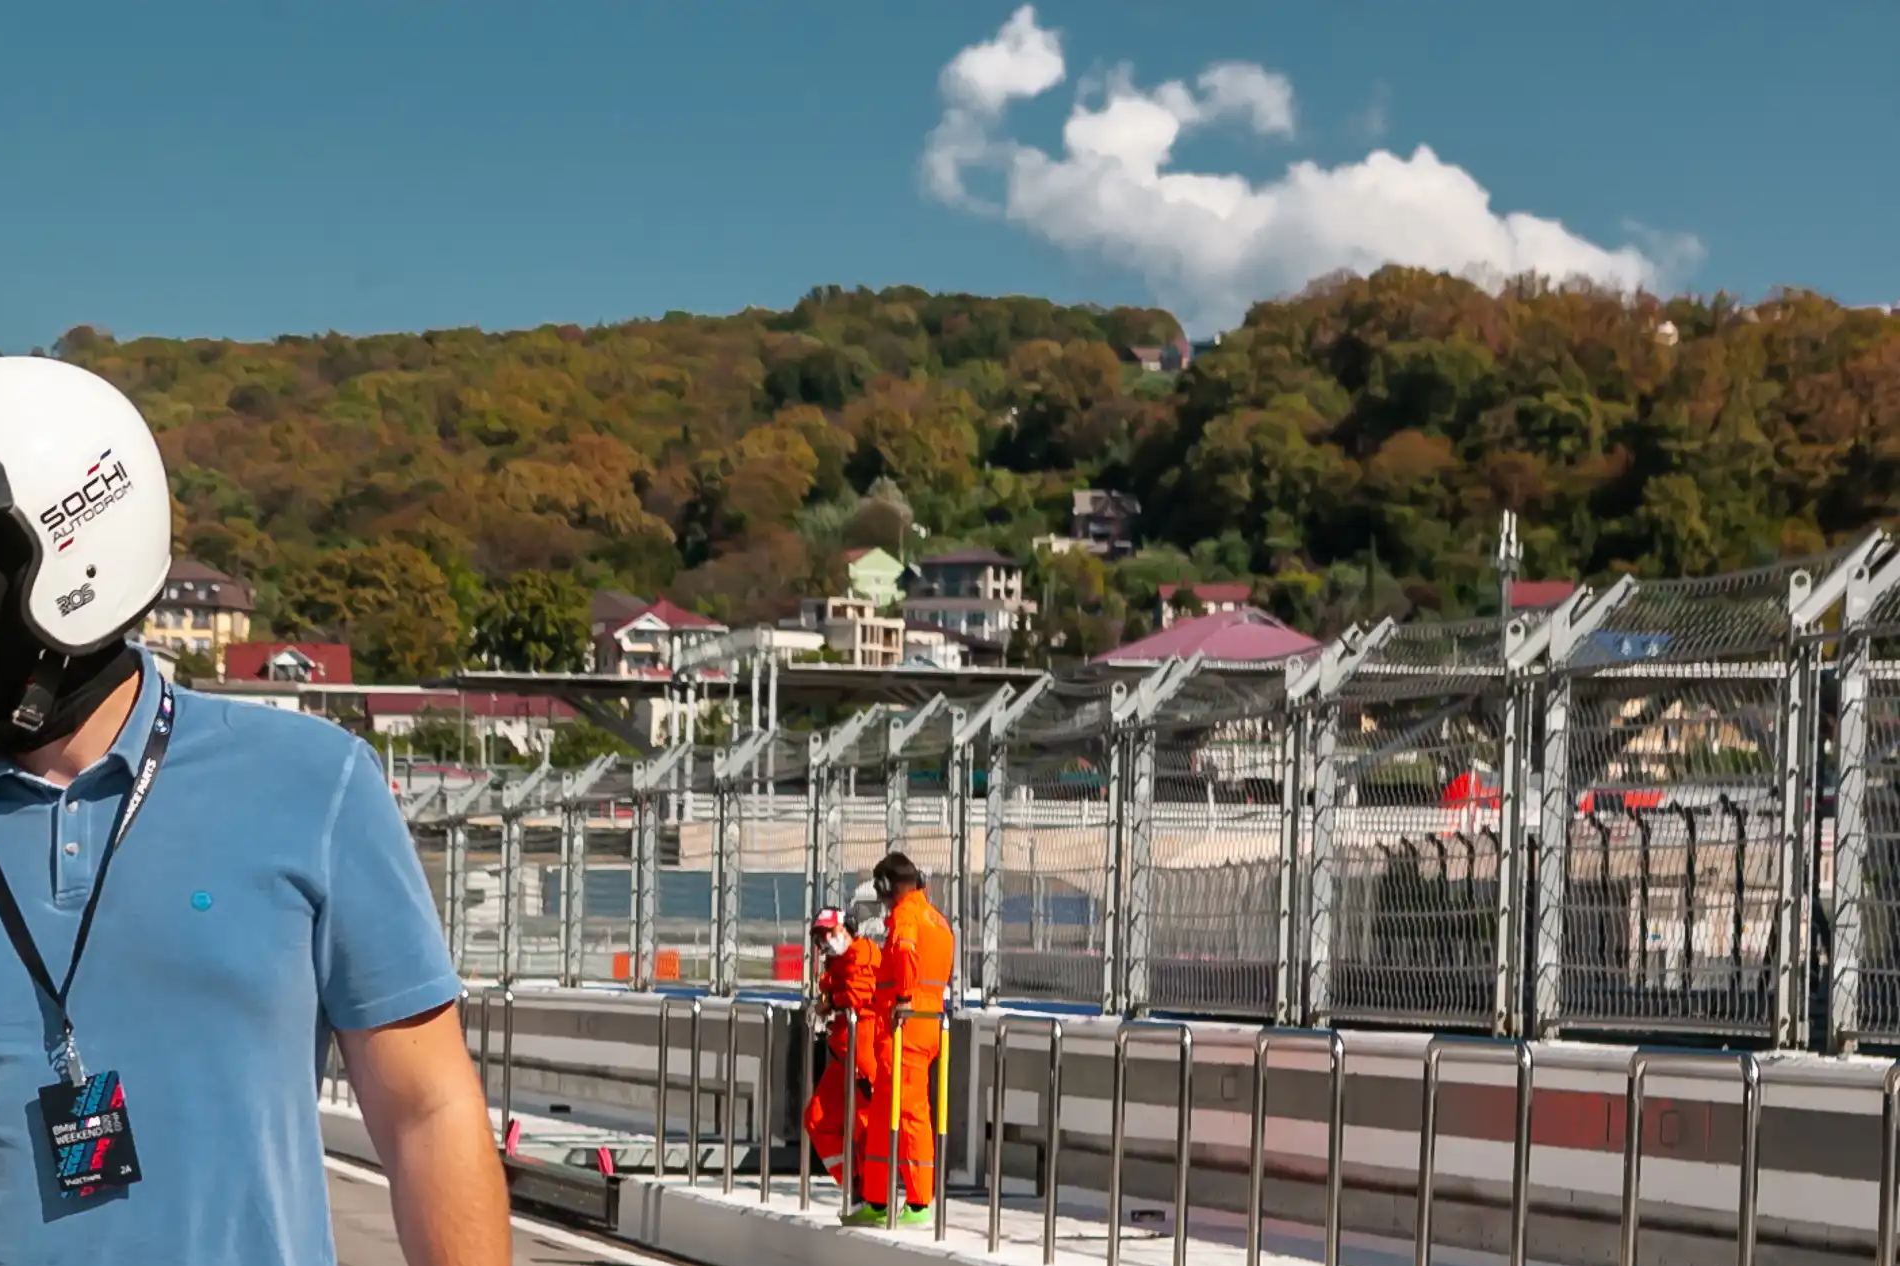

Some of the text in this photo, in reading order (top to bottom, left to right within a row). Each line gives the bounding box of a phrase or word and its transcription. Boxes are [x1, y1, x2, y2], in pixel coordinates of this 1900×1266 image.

[40, 460, 129, 532] SOCHI
[52, 480, 134, 544] AUTODROM
[137, 757, 157, 793] PARTS
[52, 1122, 77, 1136] BMW
[55, 1127, 105, 1145] WEEKEND
